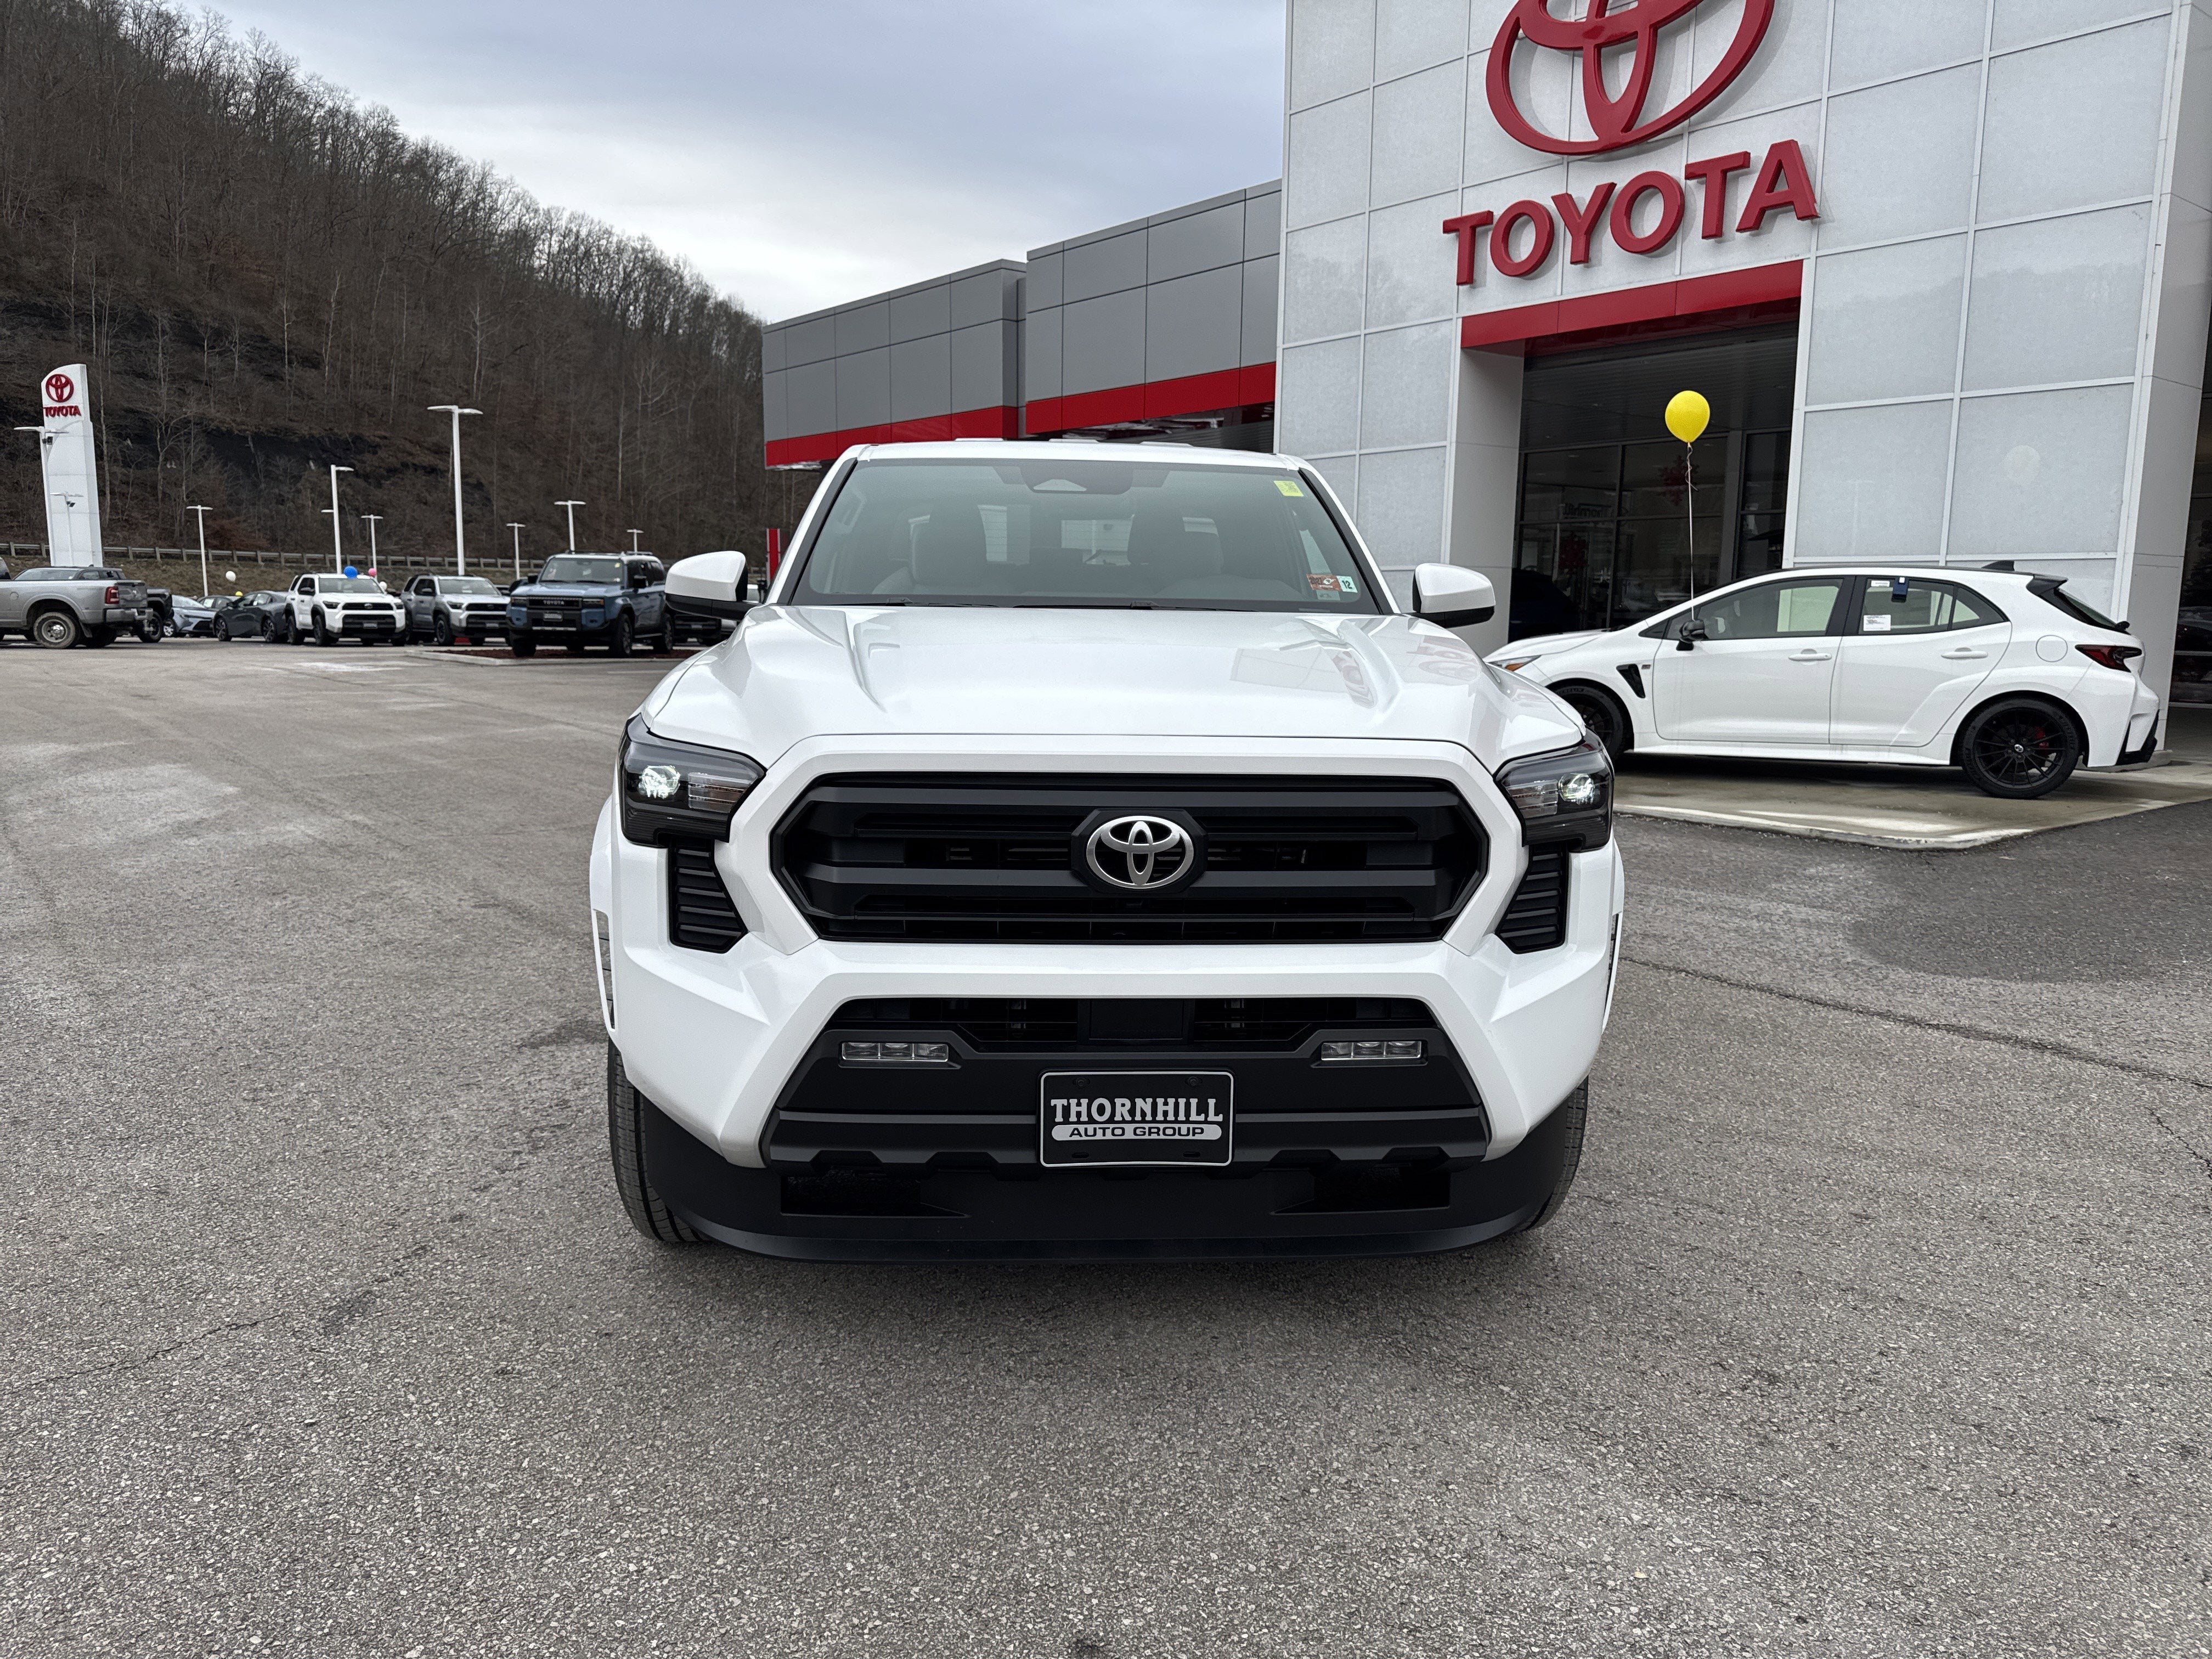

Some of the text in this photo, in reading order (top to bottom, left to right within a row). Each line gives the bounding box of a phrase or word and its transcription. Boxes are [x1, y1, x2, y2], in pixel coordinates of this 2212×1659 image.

[1443, 139, 1820, 286] TOYOTA
[43, 405, 81, 417] TOYOTA
[1341, 580, 1353, 589] 12
[1051, 1098, 1223, 1122] THORNHILL
[1069, 1126, 1204, 1137] AUTO GROUP
